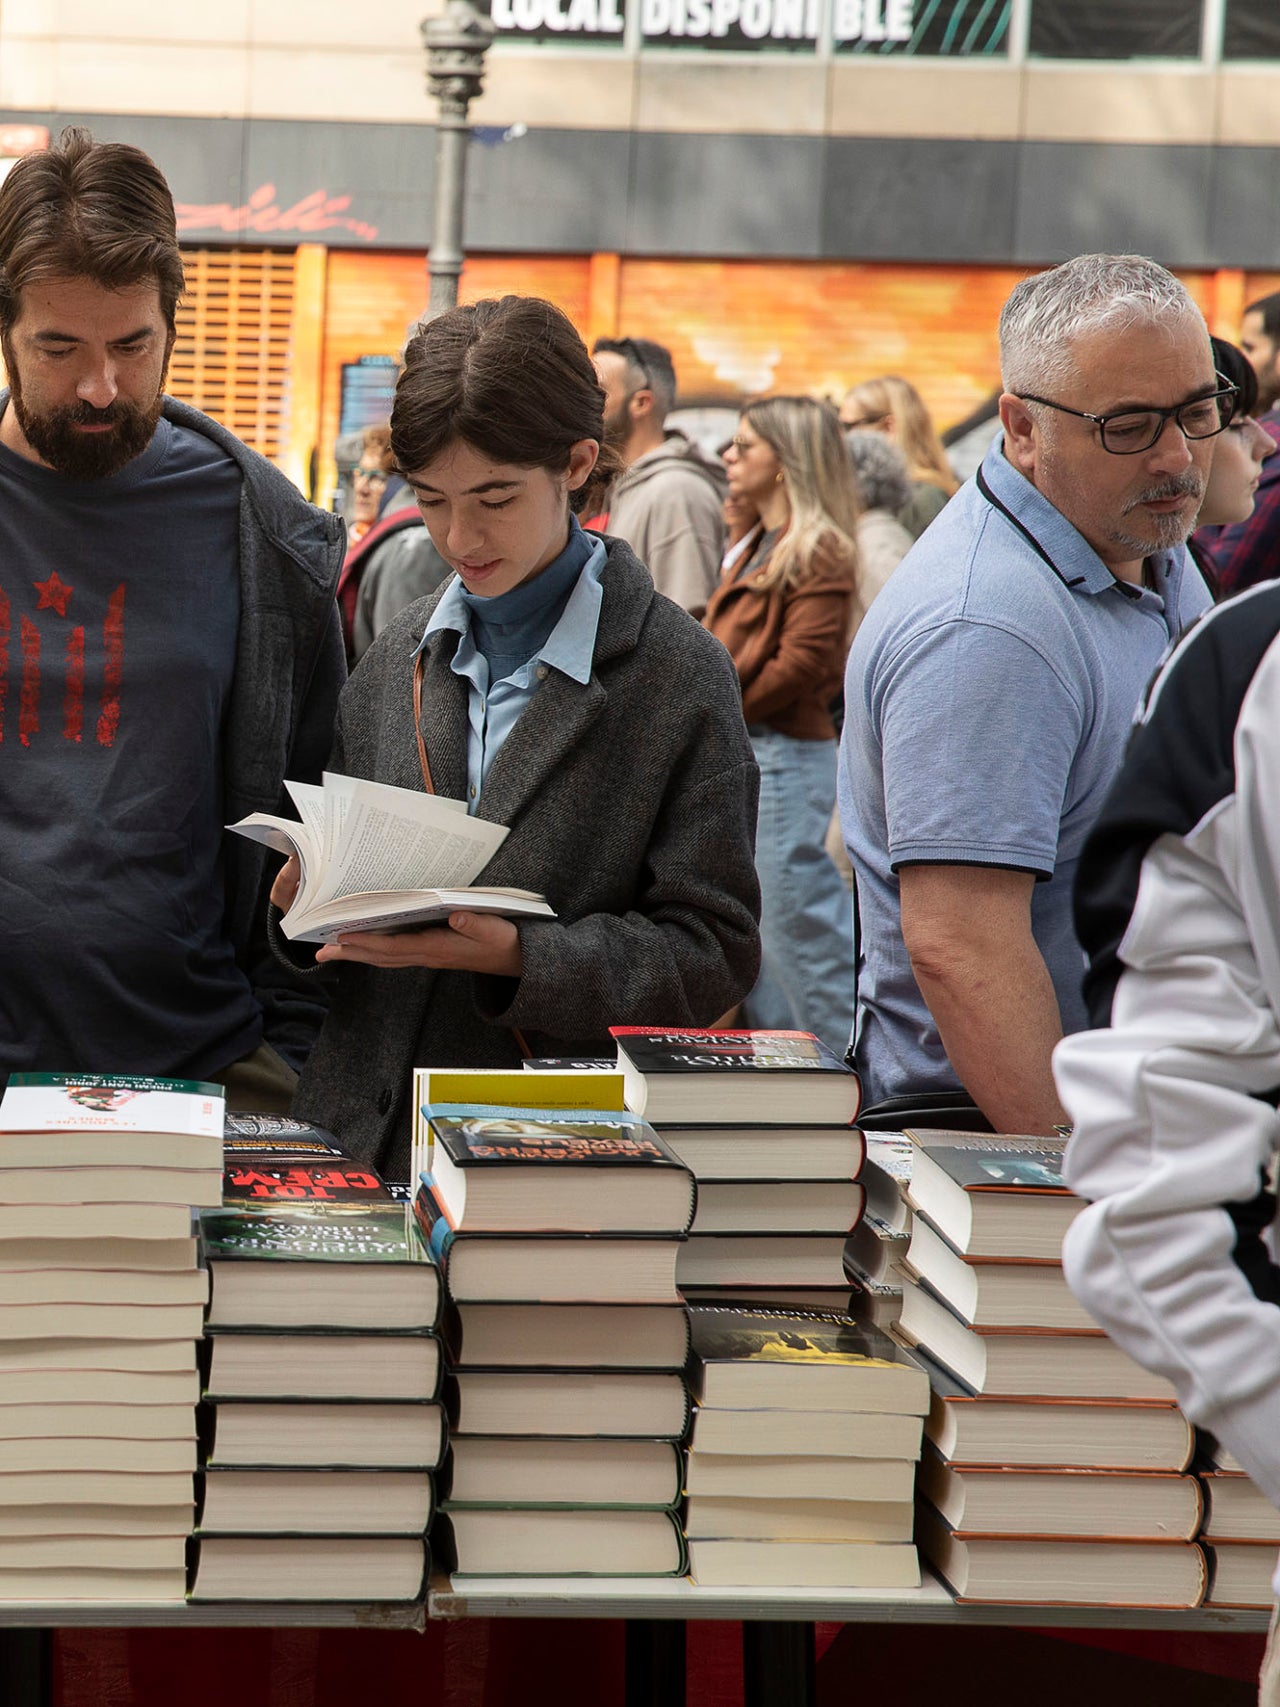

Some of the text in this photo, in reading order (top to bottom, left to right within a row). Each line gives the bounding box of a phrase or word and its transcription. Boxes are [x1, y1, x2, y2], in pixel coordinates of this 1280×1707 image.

[490, 0, 624, 31] LOCAL
[223, 1168, 380, 1189] CREM
[250, 1185, 336, 1199] TOT
